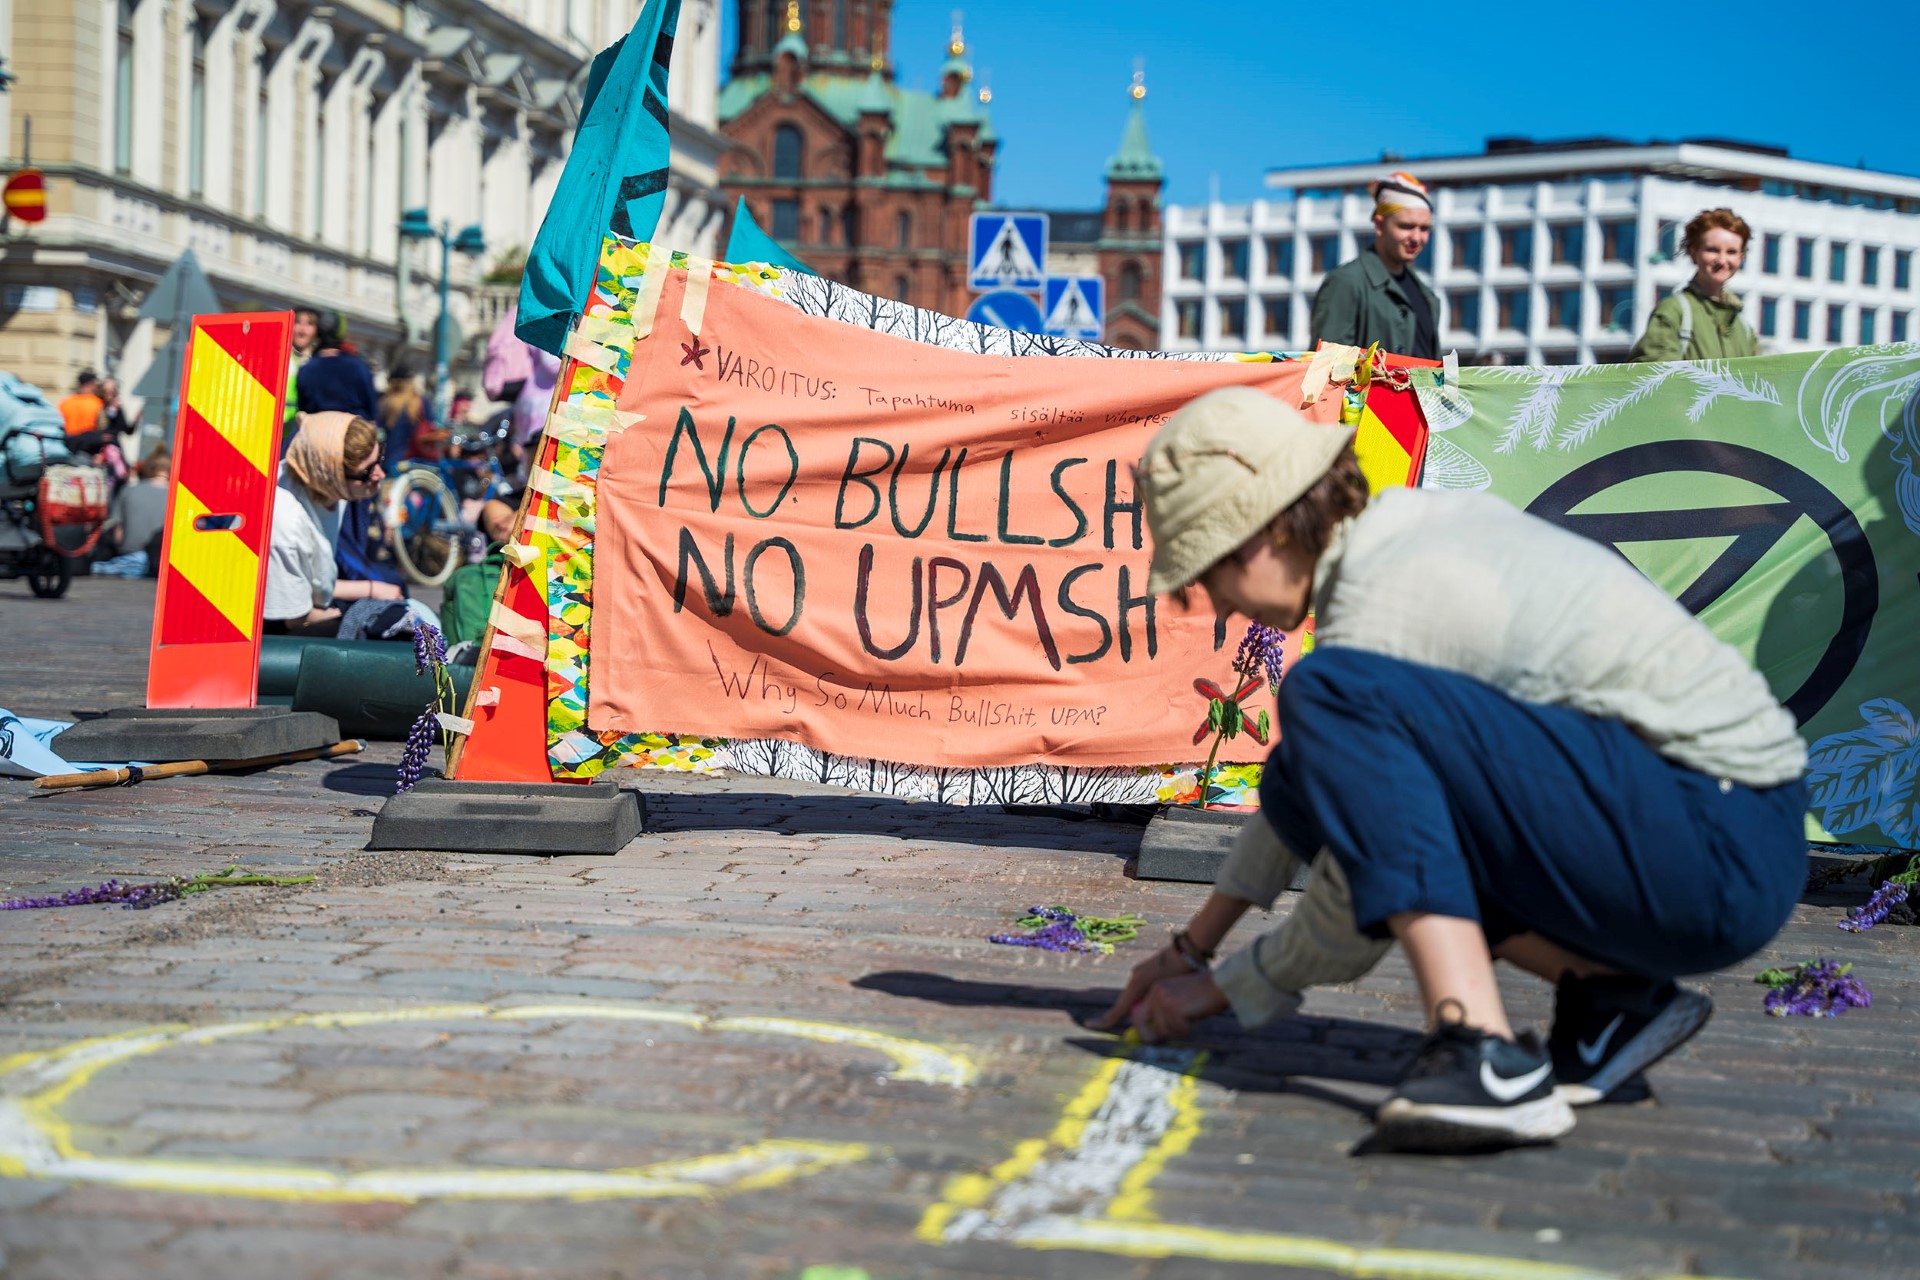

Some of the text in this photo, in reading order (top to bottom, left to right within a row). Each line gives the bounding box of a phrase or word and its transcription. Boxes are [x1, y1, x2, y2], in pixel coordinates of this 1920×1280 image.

[859, 386, 975, 415] Tapahtuma
[1010, 406, 1086, 425] sisältää
[658, 405, 1144, 550] NO BULLSH
[673, 525, 1228, 671] NO UPMSH
[706, 639, 797, 714] Why
[814, 672, 848, 710] So
[857, 680, 931, 721] Much
[1051, 706, 1107, 727] UPM?
